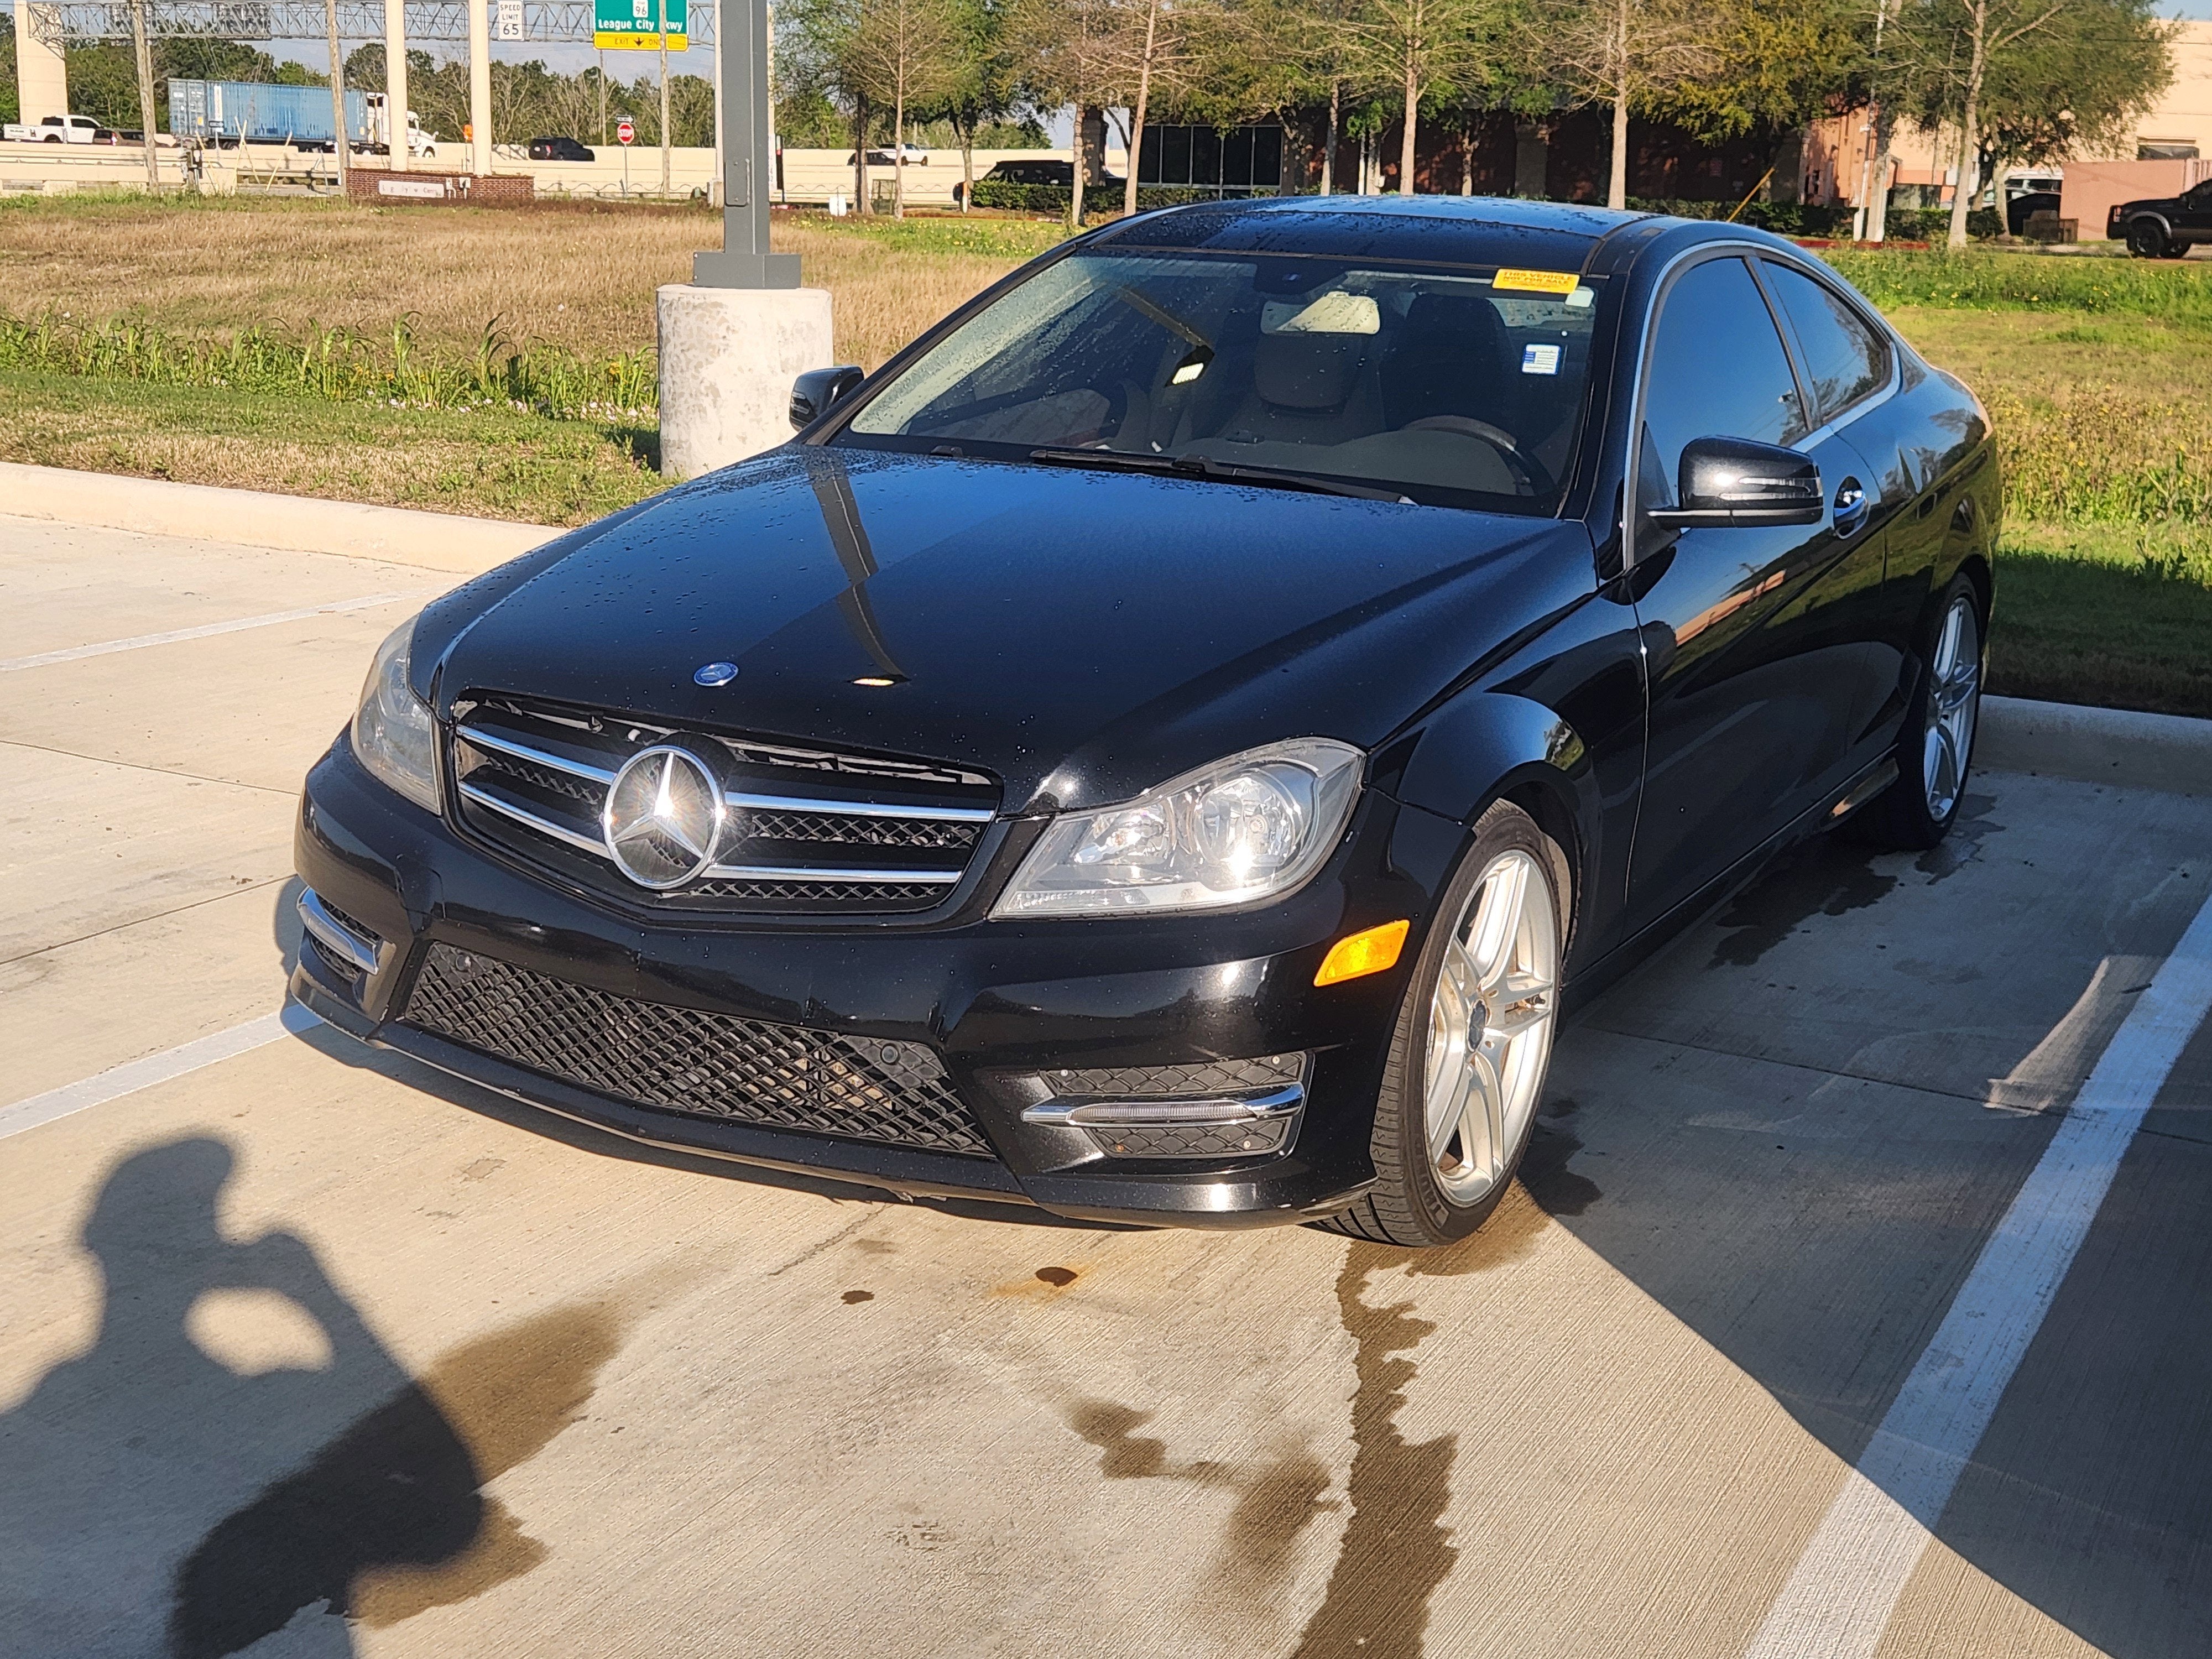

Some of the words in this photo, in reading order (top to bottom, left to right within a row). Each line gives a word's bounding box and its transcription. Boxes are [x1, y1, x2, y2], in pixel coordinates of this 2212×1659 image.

[635, 6, 647, 15] 96
[503, 23, 519, 35] 65
[598, 18, 633, 30] League
[635, 19, 655, 32] City
